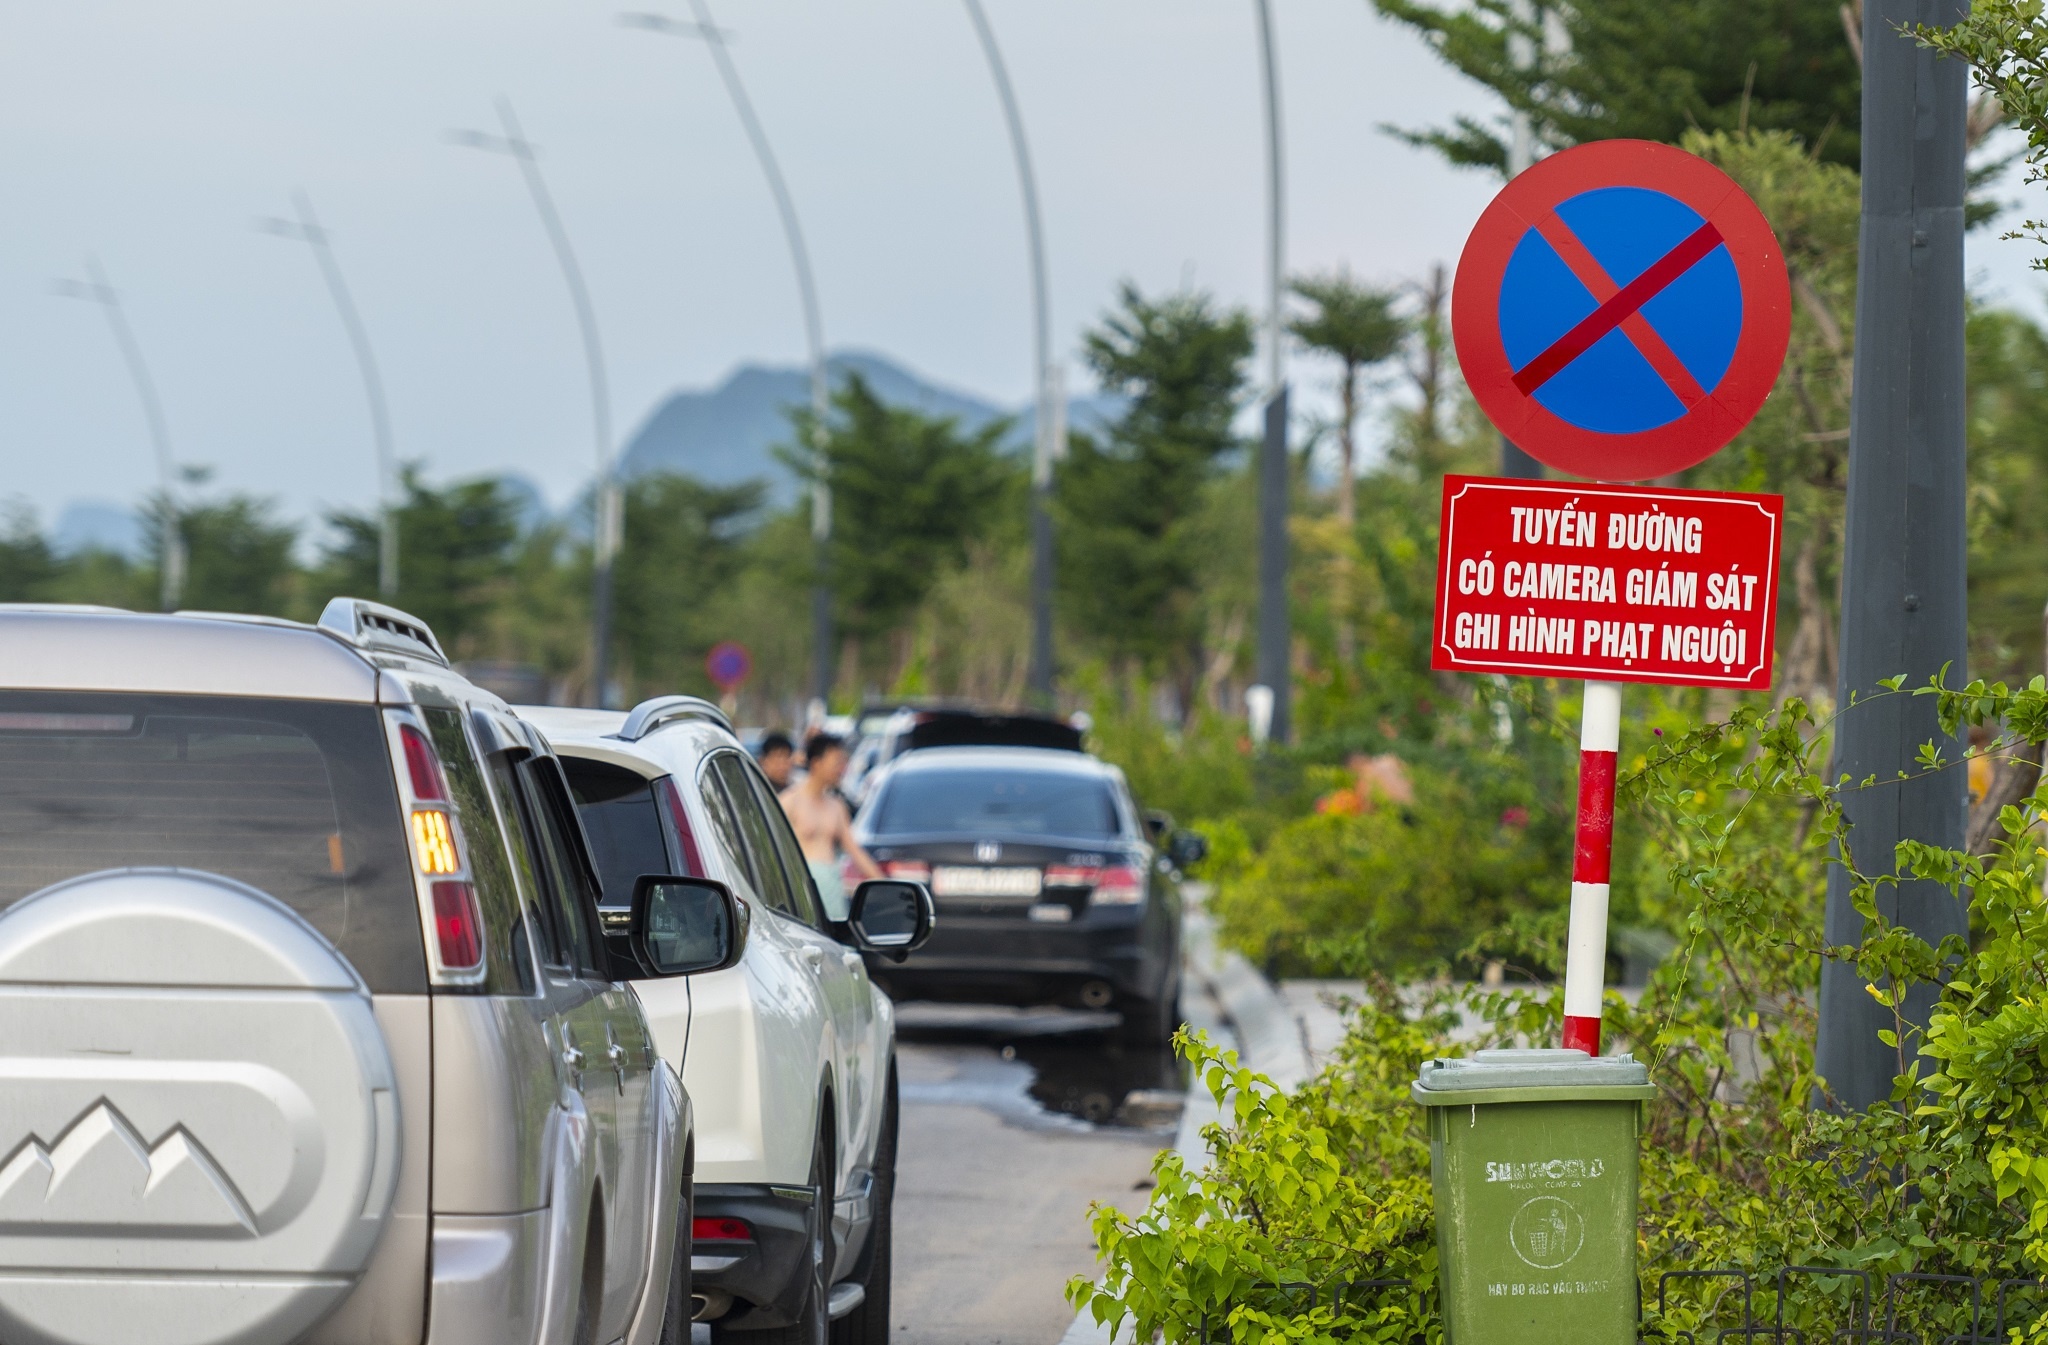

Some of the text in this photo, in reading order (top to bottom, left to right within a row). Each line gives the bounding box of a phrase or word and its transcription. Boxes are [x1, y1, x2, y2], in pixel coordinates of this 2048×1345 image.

[1511, 498, 1703, 554] TUYẾN ĐƯỜNG
[1458, 551, 1758, 611] CÓ CAMERA GIÁM SÁT
[1455, 608, 1747, 673] GHI HÌNH PHẠT NGUỘI
